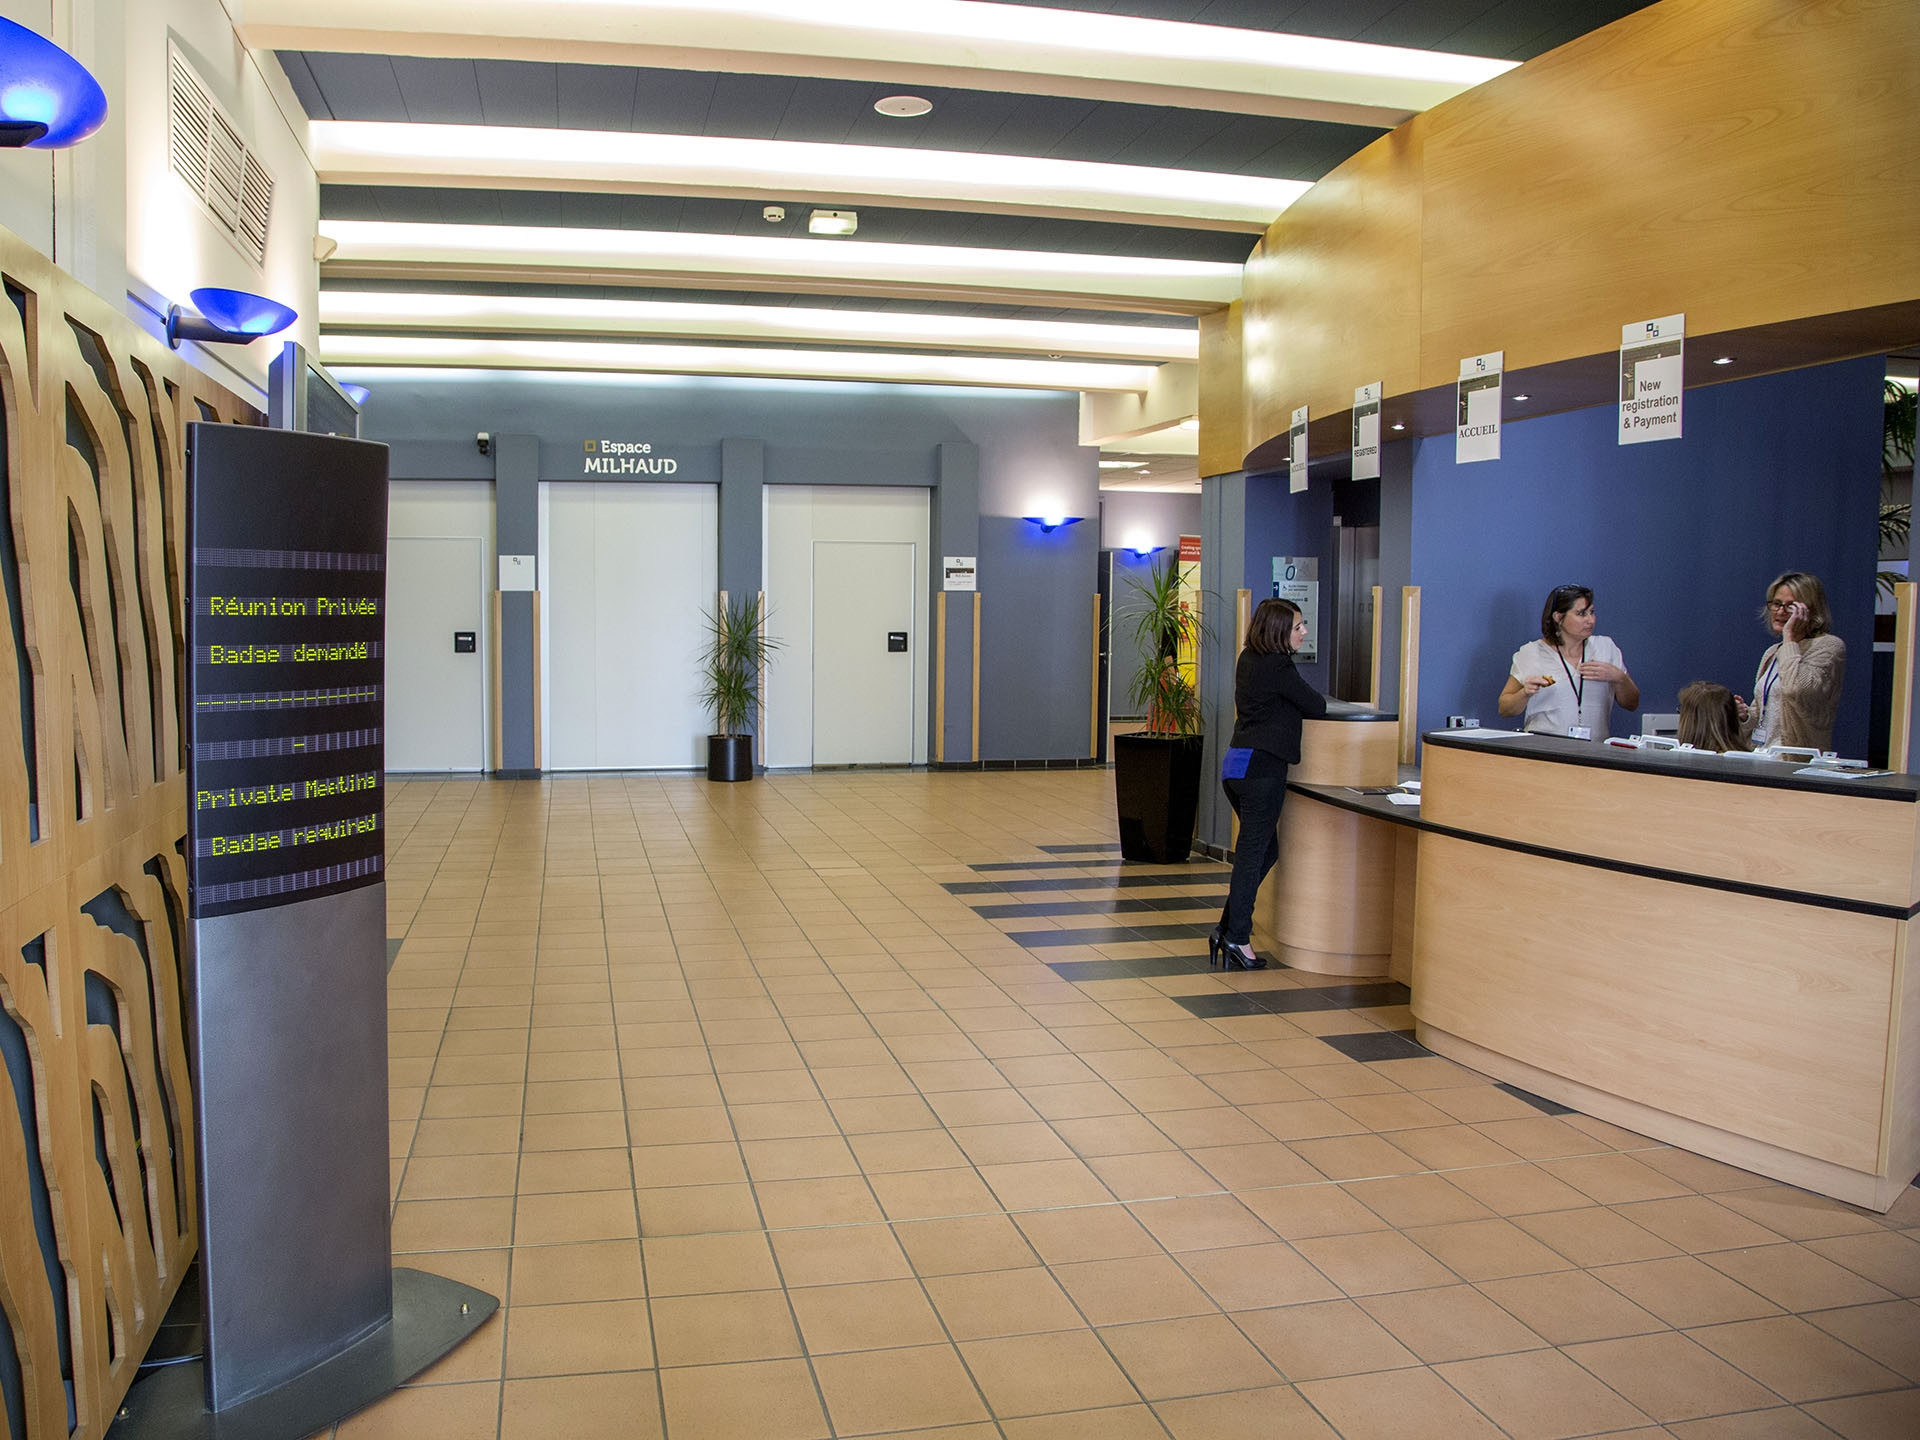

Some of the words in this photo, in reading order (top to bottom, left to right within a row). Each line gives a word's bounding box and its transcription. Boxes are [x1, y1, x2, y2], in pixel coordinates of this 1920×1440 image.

[1639, 380, 1661, 393] New
[1622, 394, 1679, 413] registration
[1623, 417, 1631, 429] &
[1633, 412, 1677, 429] Payment
[1458, 424, 1498, 438] ACCUEIL
[600, 440, 651, 456] Espace
[584, 457, 678, 474] MILHAUD
[210, 596, 306, 616] Réunion
[317, 597, 377, 616] Privée
[293, 641, 367, 662] demandé
[197, 784, 293, 810] Private
[293, 813, 376, 846] required
